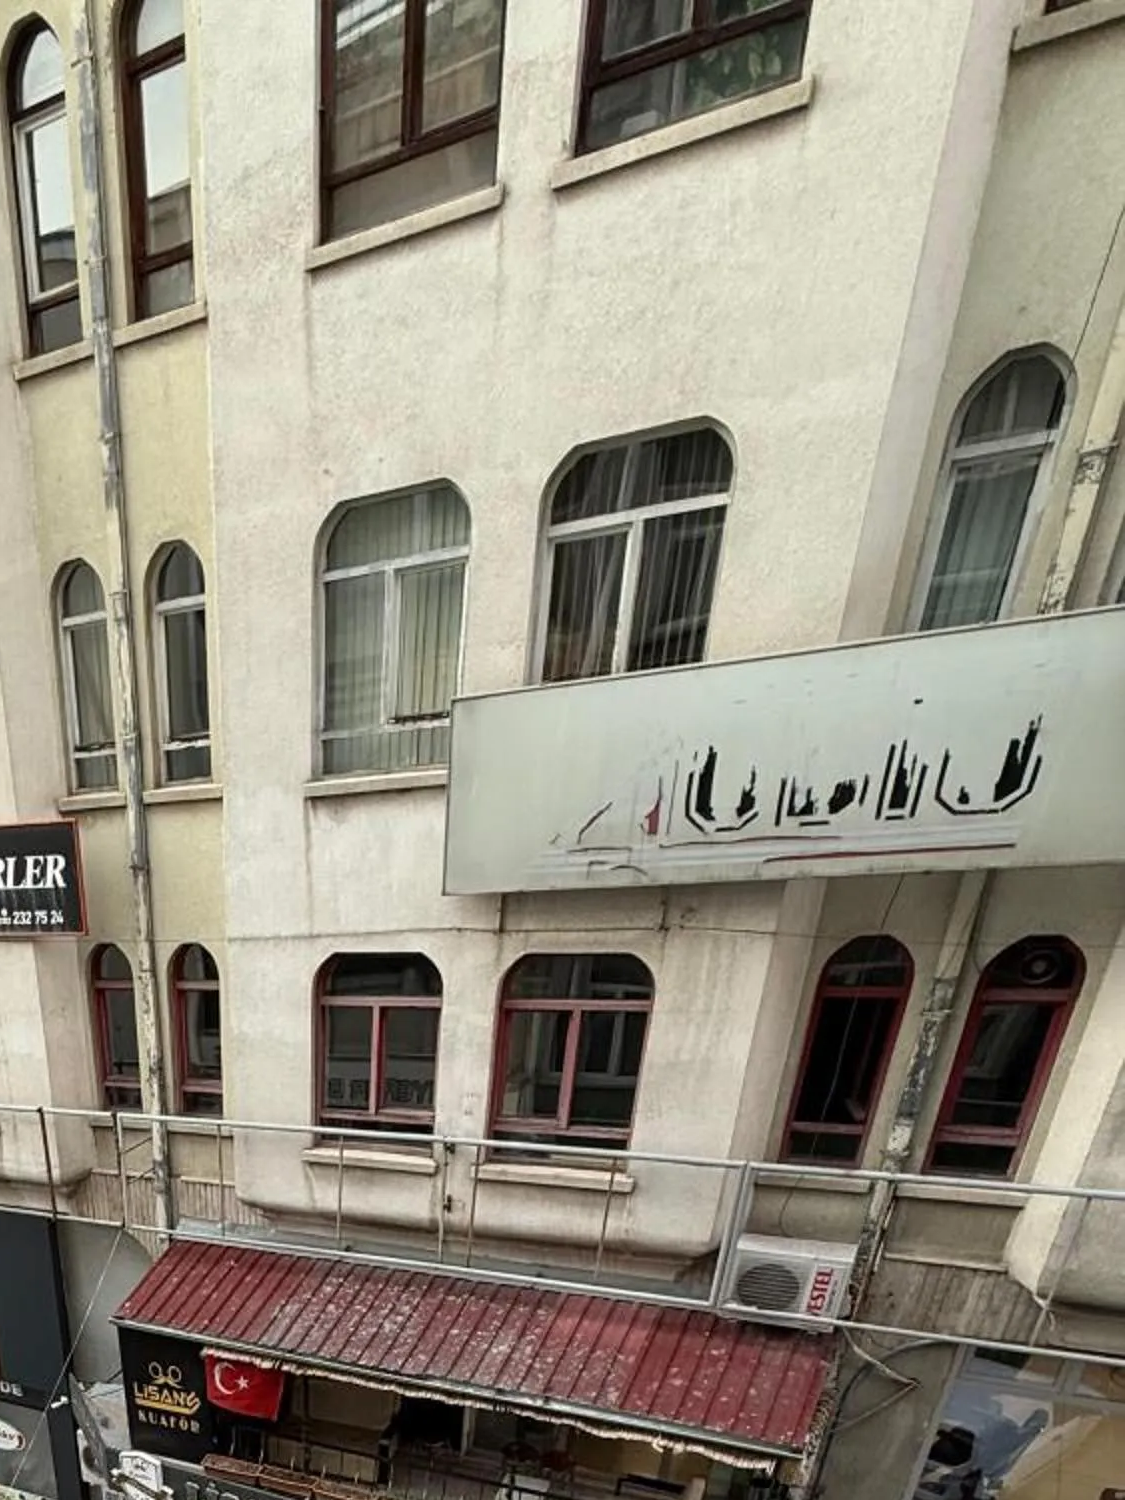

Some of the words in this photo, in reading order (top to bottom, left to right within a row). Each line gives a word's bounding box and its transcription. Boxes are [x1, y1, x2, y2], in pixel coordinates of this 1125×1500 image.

[12, 911, 32, 925] 232
[35, 910, 48, 925] 75
[138, 1409, 201, 1434] KUAFÖR
